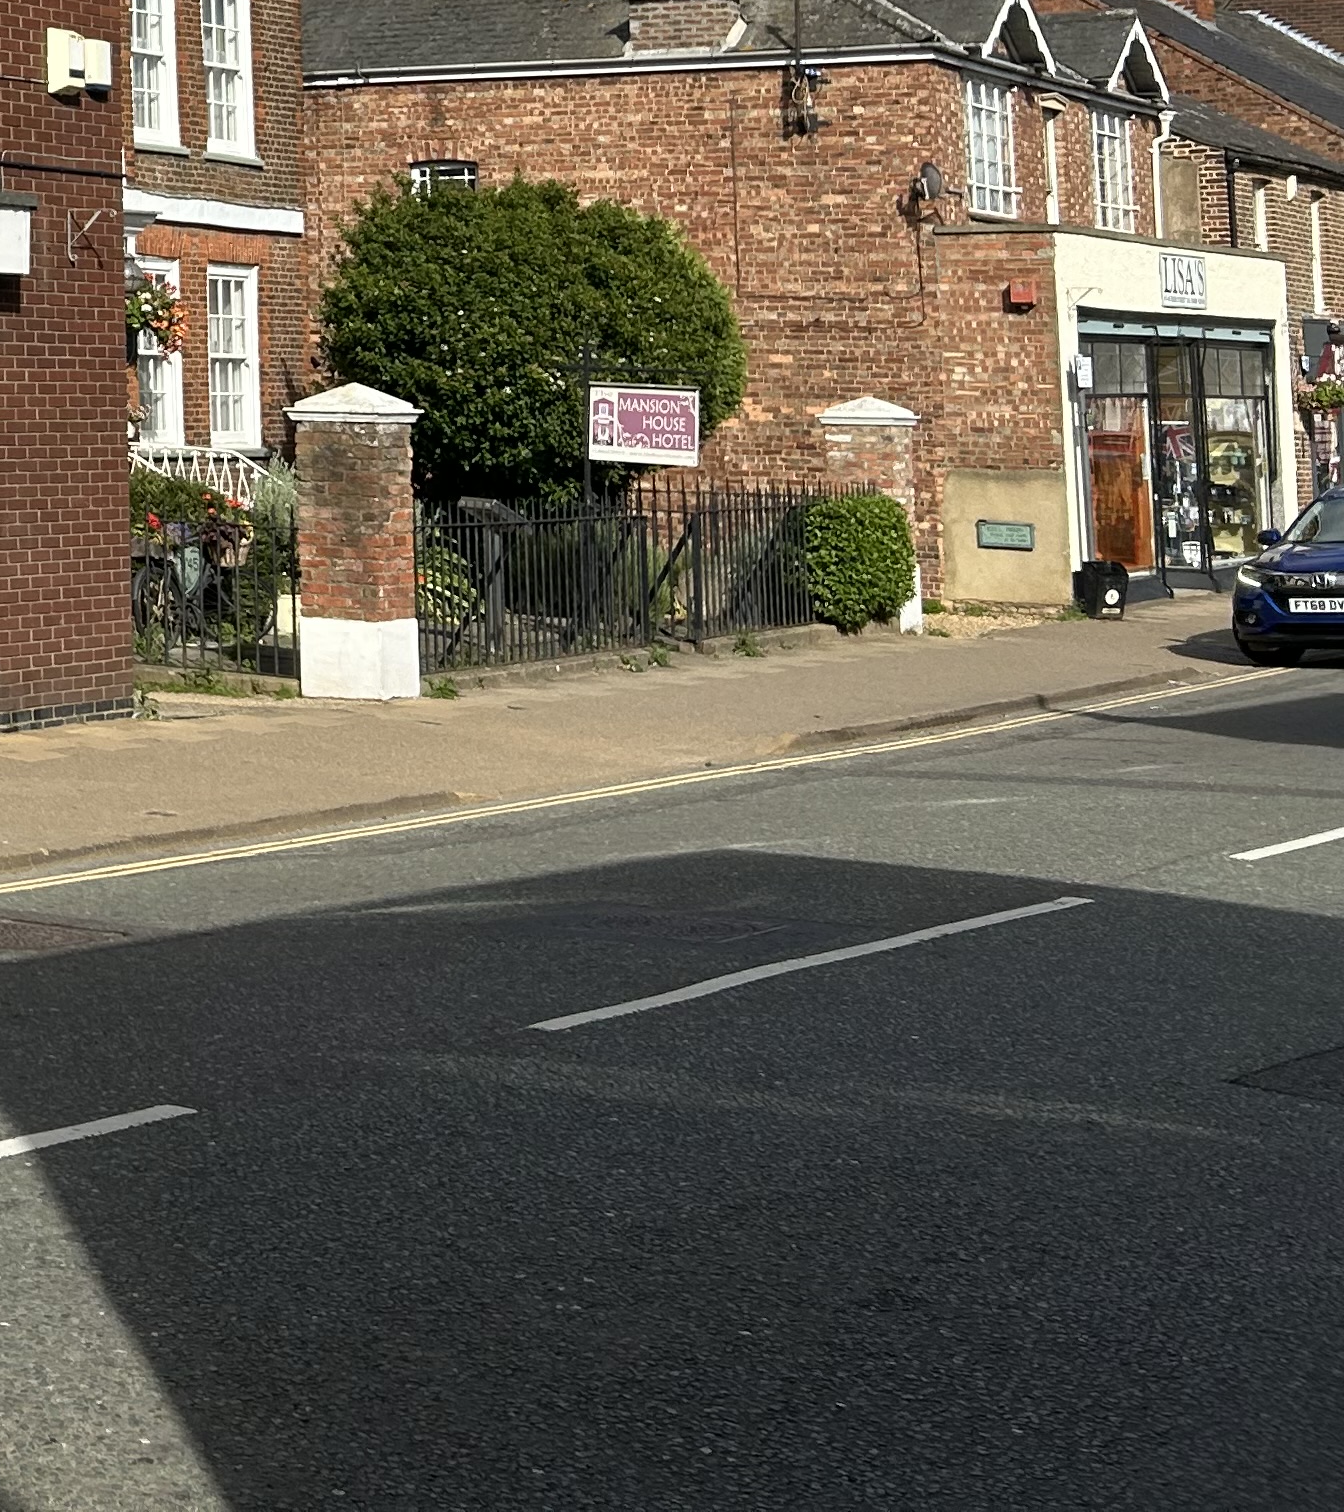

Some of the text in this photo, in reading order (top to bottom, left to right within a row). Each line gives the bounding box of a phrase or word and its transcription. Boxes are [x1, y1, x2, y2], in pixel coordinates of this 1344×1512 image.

[1161, 256, 1205, 296] LISA'S
[618, 397, 681, 414] MANSION
[642, 414, 687, 432] HOUSE
[652, 432, 695, 450] HOTEL
[1294, 600, 1326, 611] FT68
